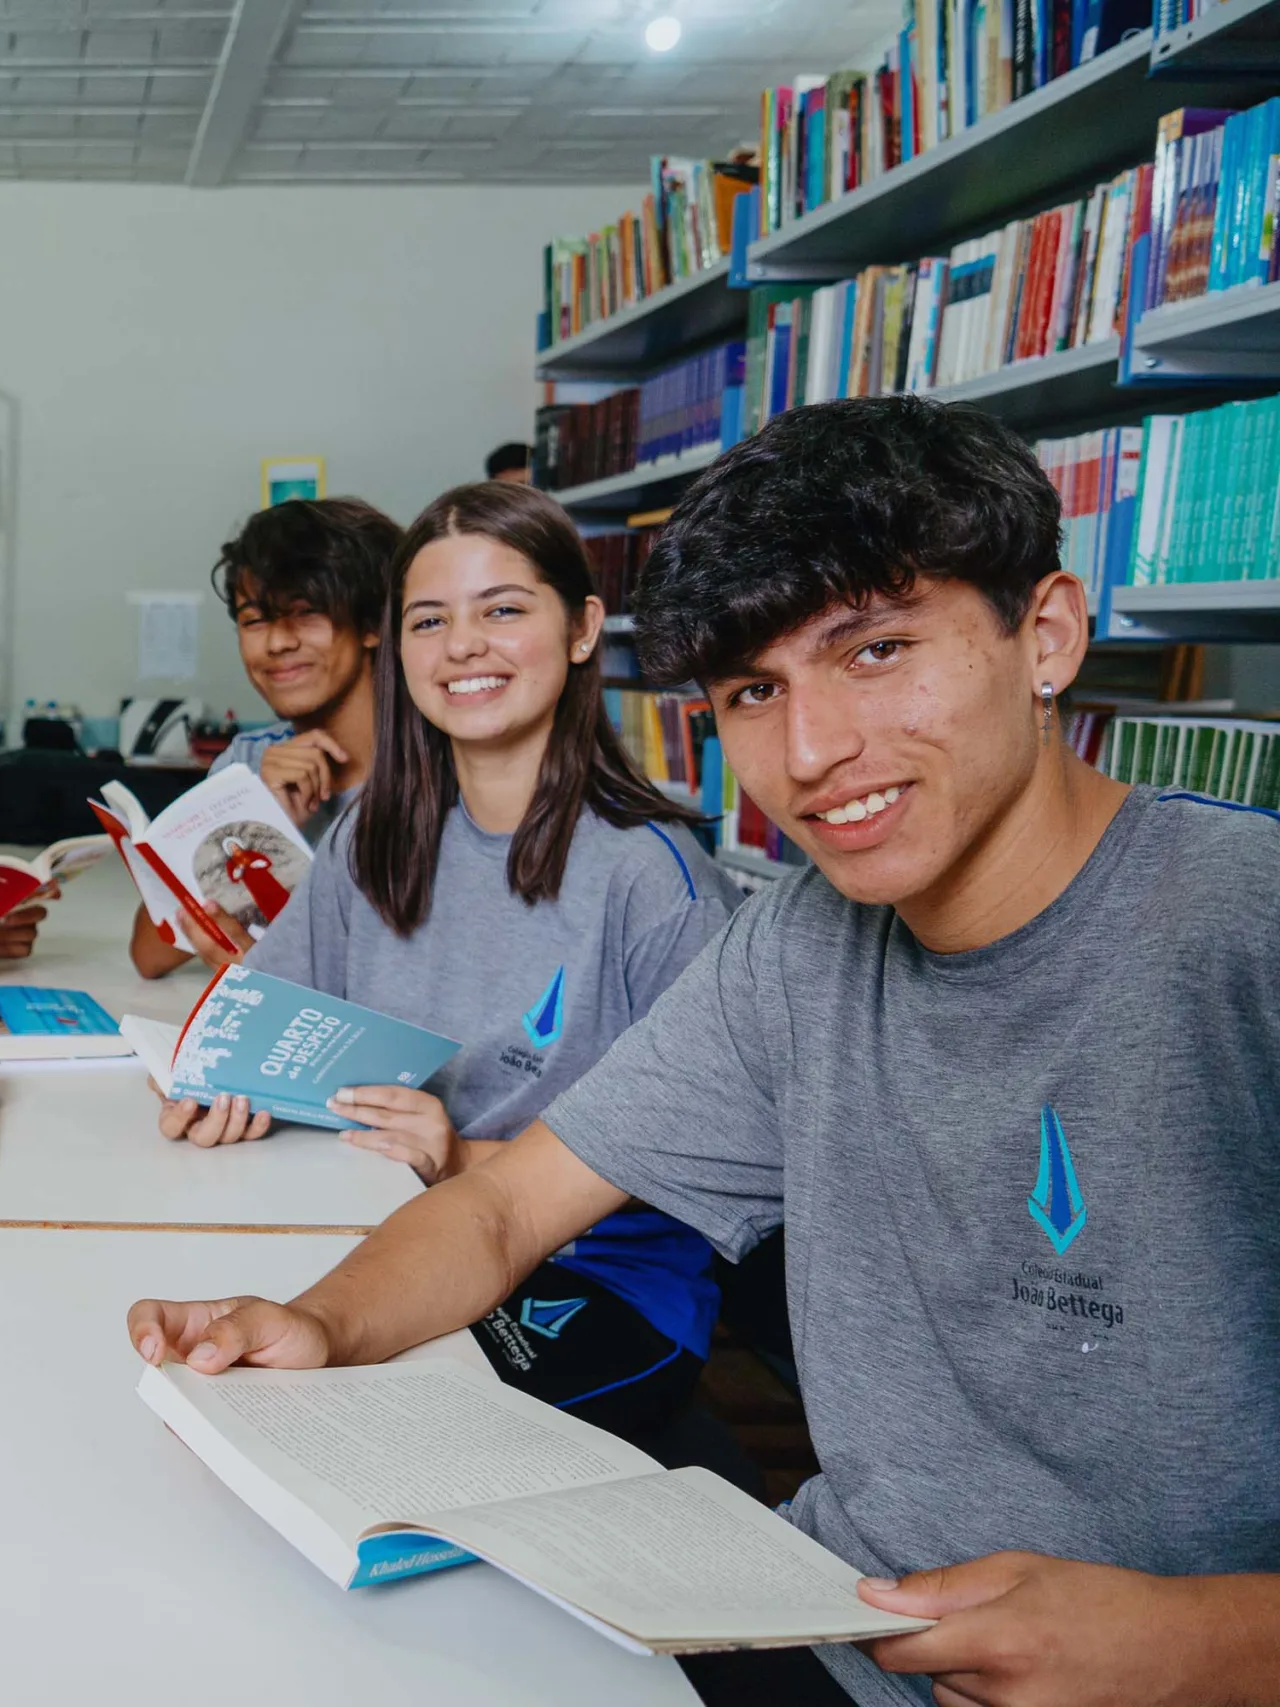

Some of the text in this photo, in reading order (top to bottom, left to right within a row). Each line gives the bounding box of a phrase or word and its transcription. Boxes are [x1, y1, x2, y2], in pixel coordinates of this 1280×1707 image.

[260, 1008, 323, 1077] QUARTO
[292, 1016, 342, 1065] DESPEJO
[1046, 1287, 1124, 1329] Bettega
[492, 1319, 531, 1371] Bettega
[509, 1322, 538, 1359] Estadual
